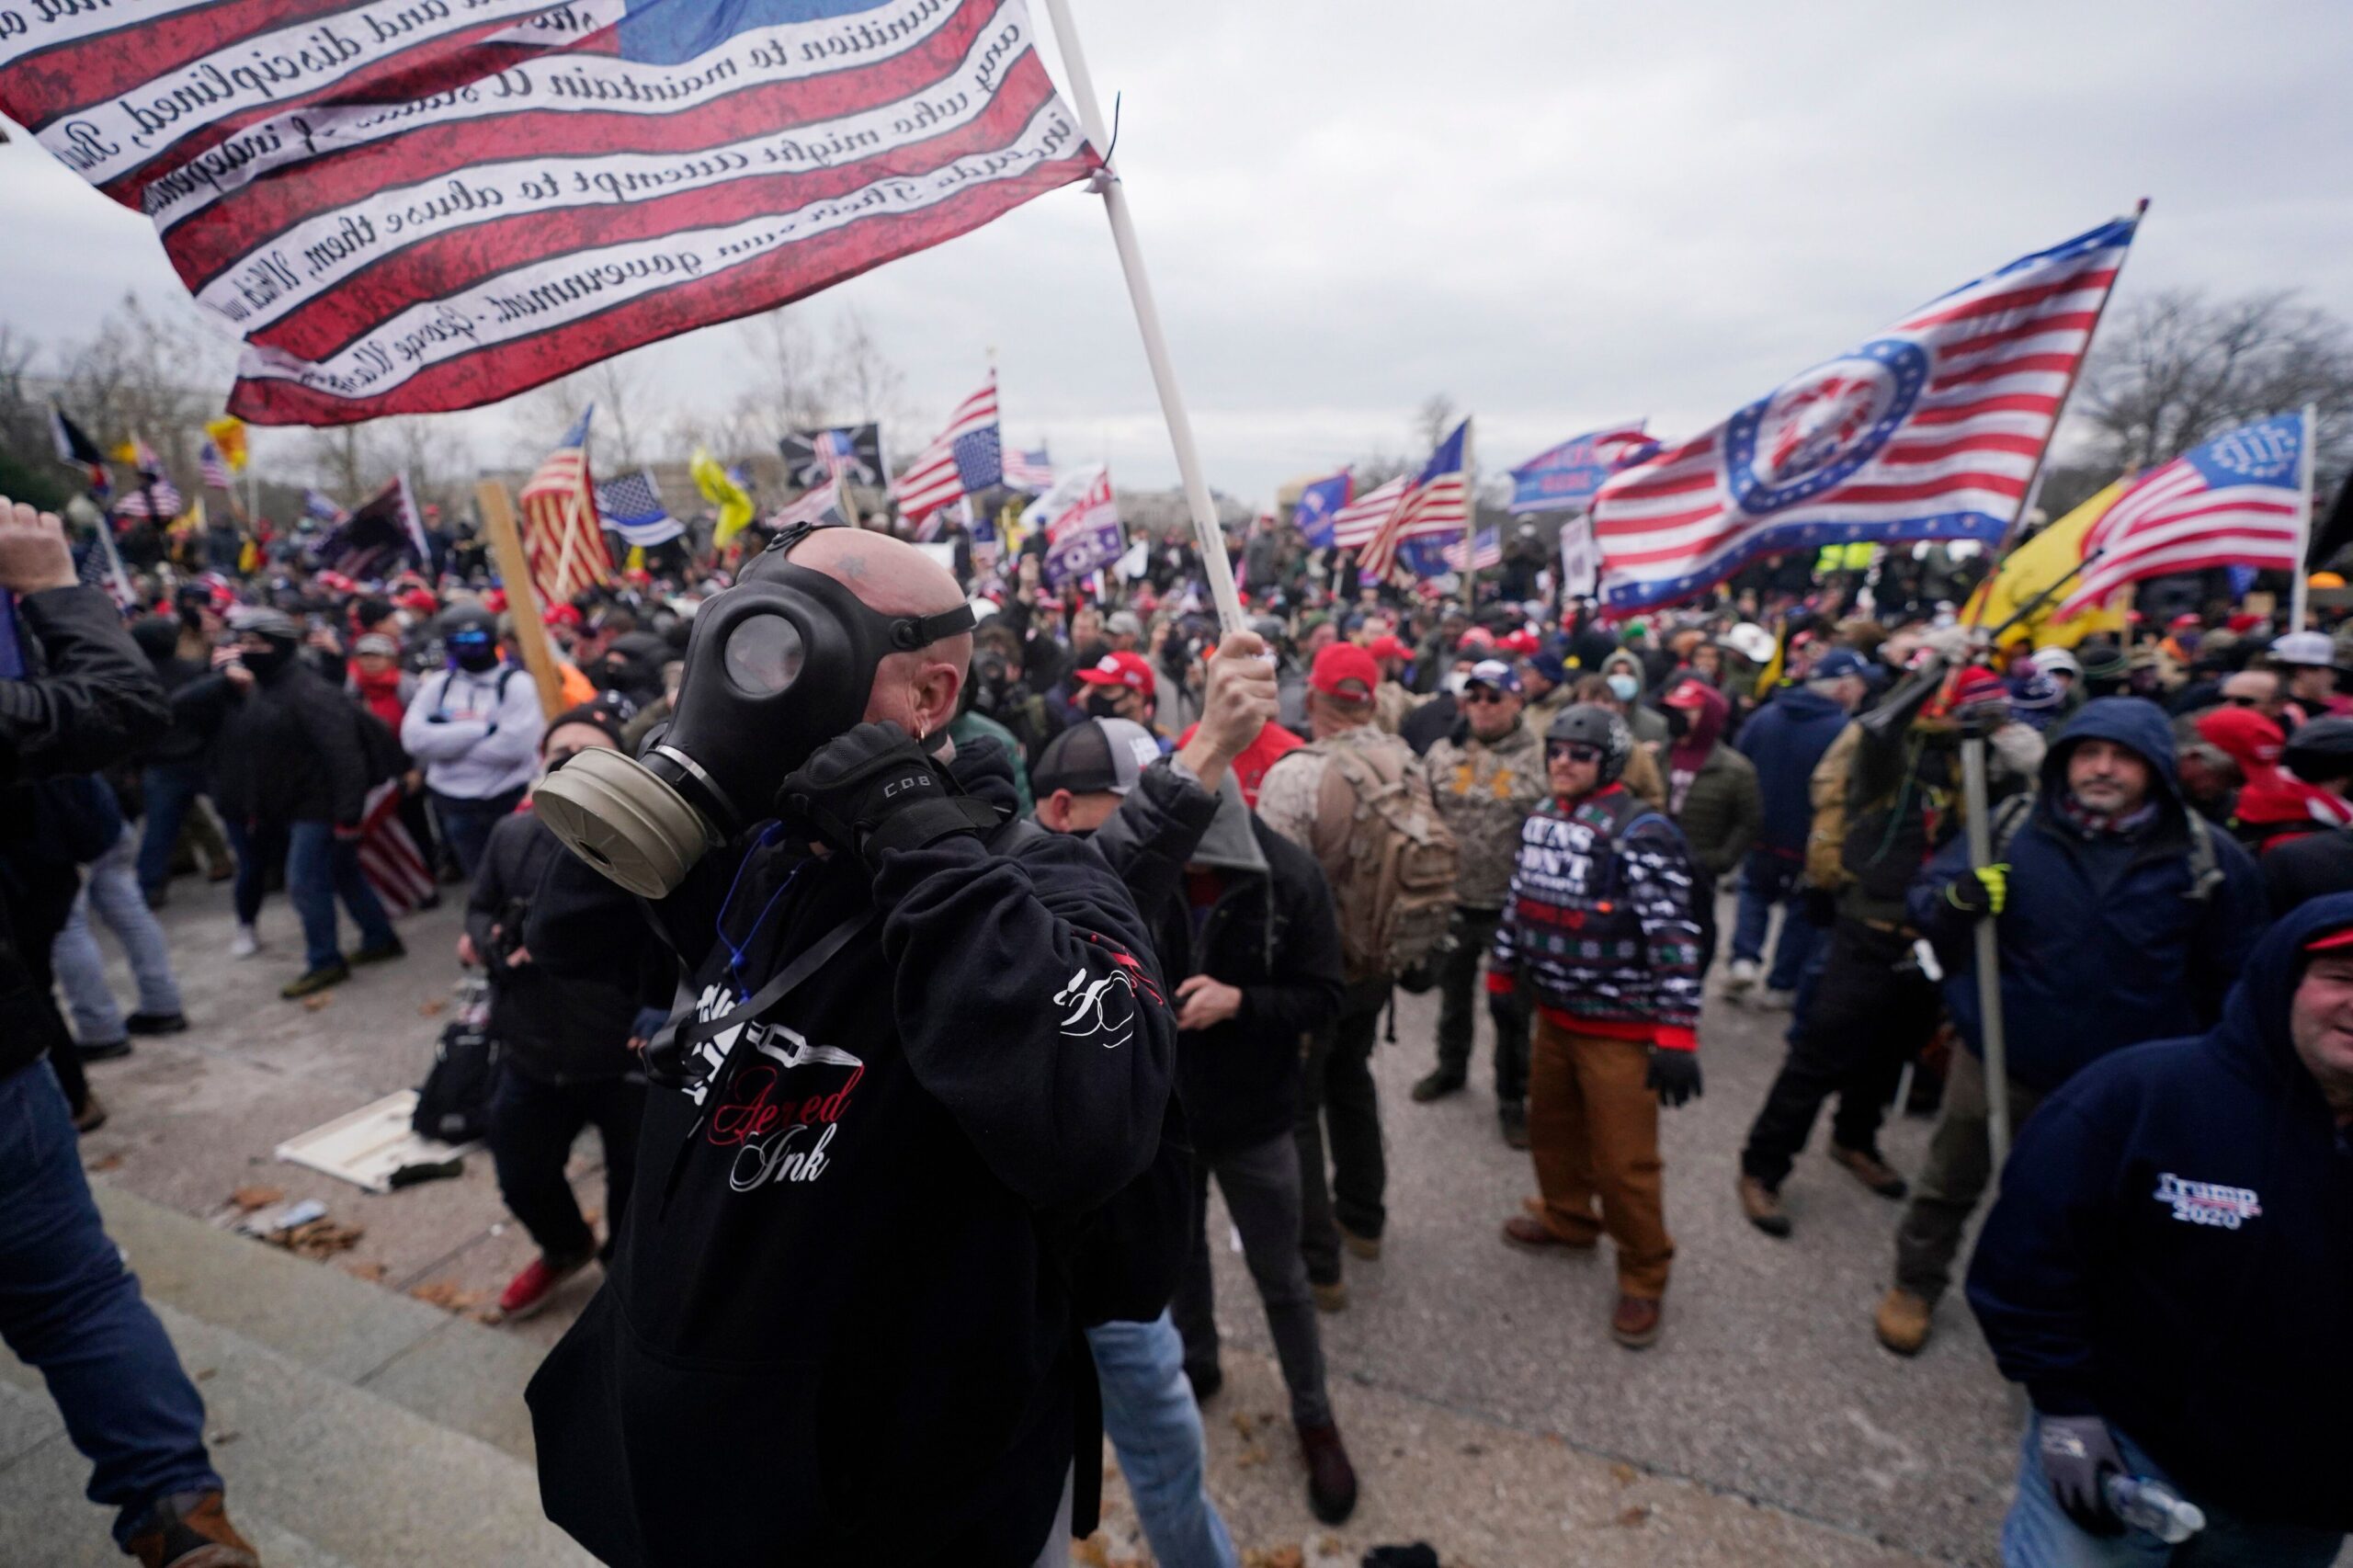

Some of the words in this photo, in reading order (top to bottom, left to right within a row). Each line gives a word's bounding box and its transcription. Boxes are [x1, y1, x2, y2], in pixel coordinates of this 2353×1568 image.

[730, 1122, 838, 1192] Ink
[2153, 1172, 2262, 1220] Trump
[2172, 1199, 2241, 1230] 2020
